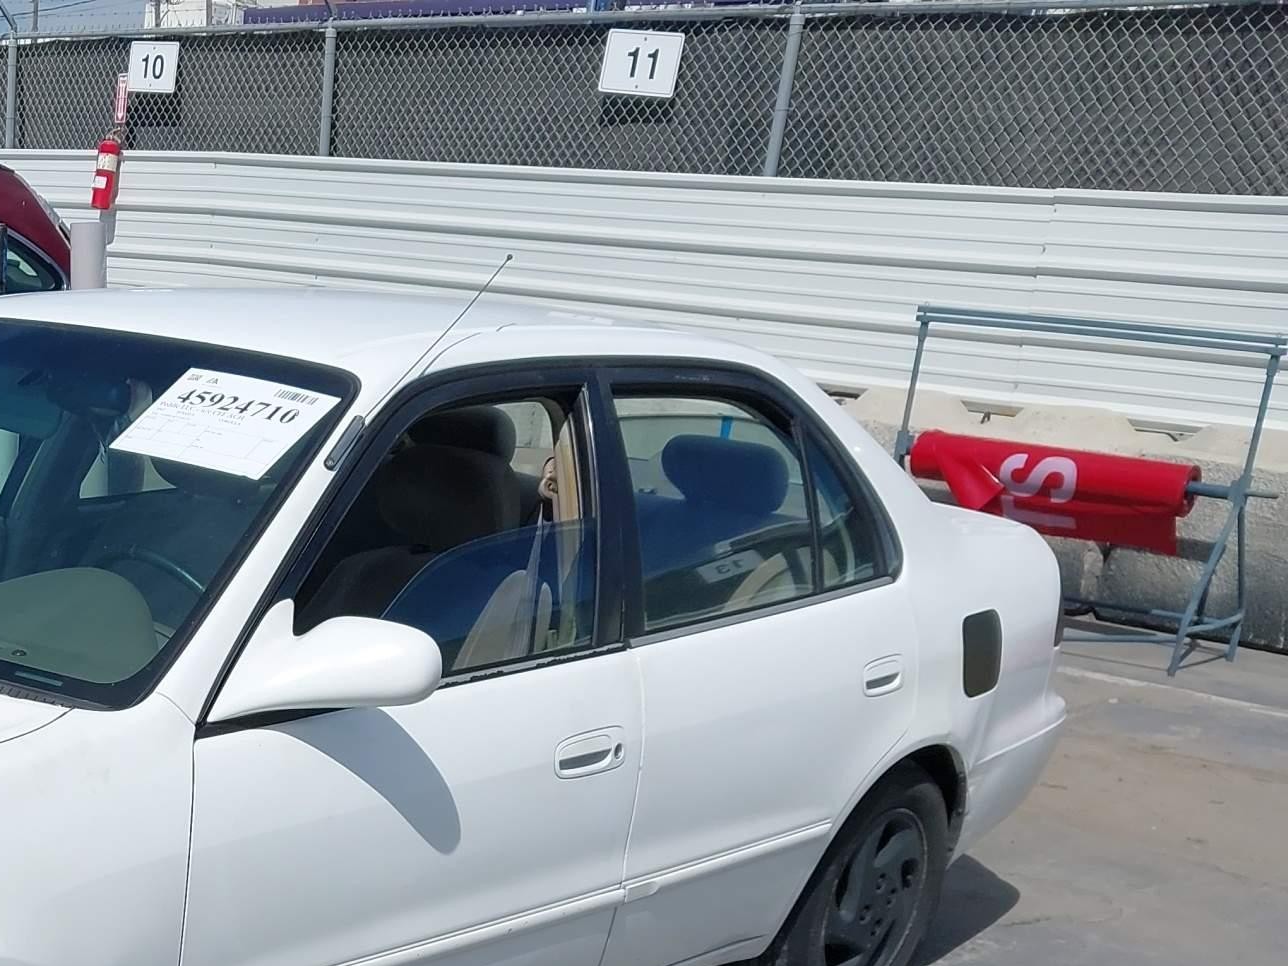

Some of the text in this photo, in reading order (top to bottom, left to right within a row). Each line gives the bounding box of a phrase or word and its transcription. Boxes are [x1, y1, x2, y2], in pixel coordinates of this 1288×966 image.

[142, 54, 164, 80] 10
[627, 47, 660, 80] 11
[177, 389, 299, 424] 45924710
